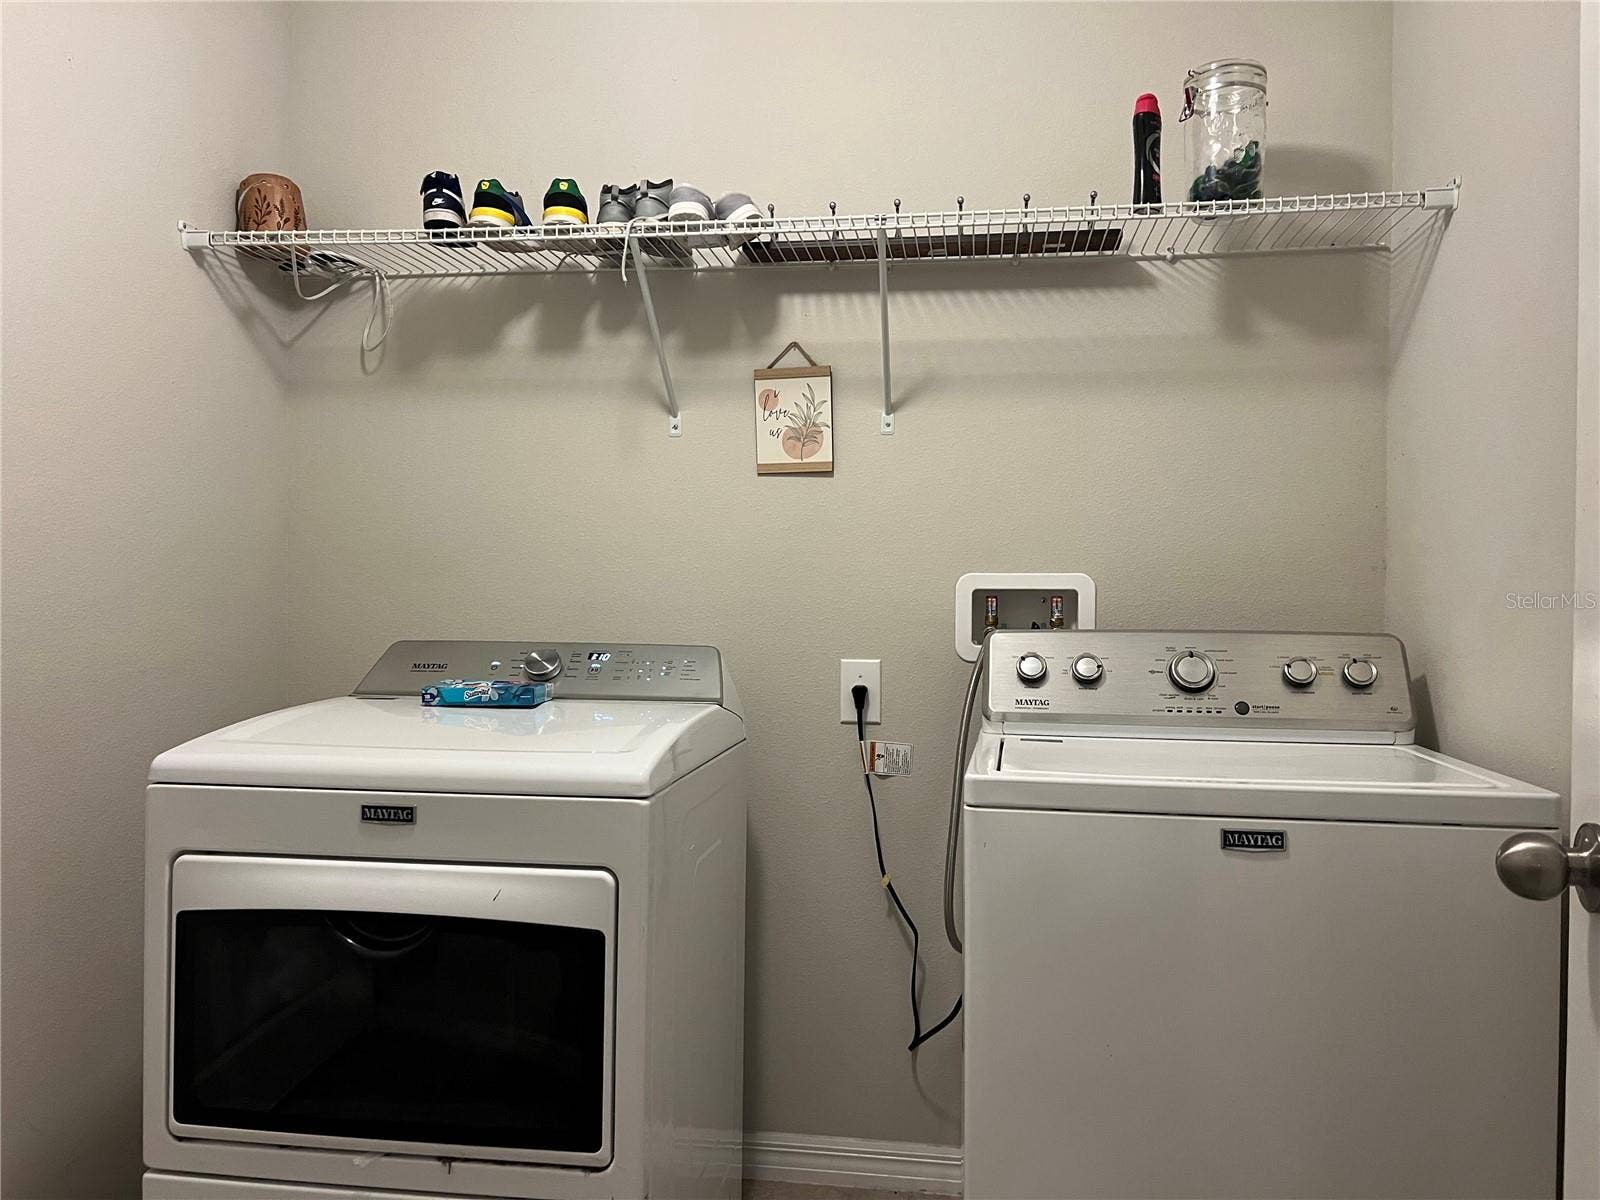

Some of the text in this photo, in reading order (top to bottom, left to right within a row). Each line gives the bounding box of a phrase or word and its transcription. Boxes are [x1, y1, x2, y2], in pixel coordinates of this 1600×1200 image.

[762, 393, 790, 421] love
[769, 427, 782, 439] us
[1015, 698, 1050, 706] MAYTAG
[363, 807, 412, 820] MAYTAG
[1225, 833, 1283, 846] MAYTAG
